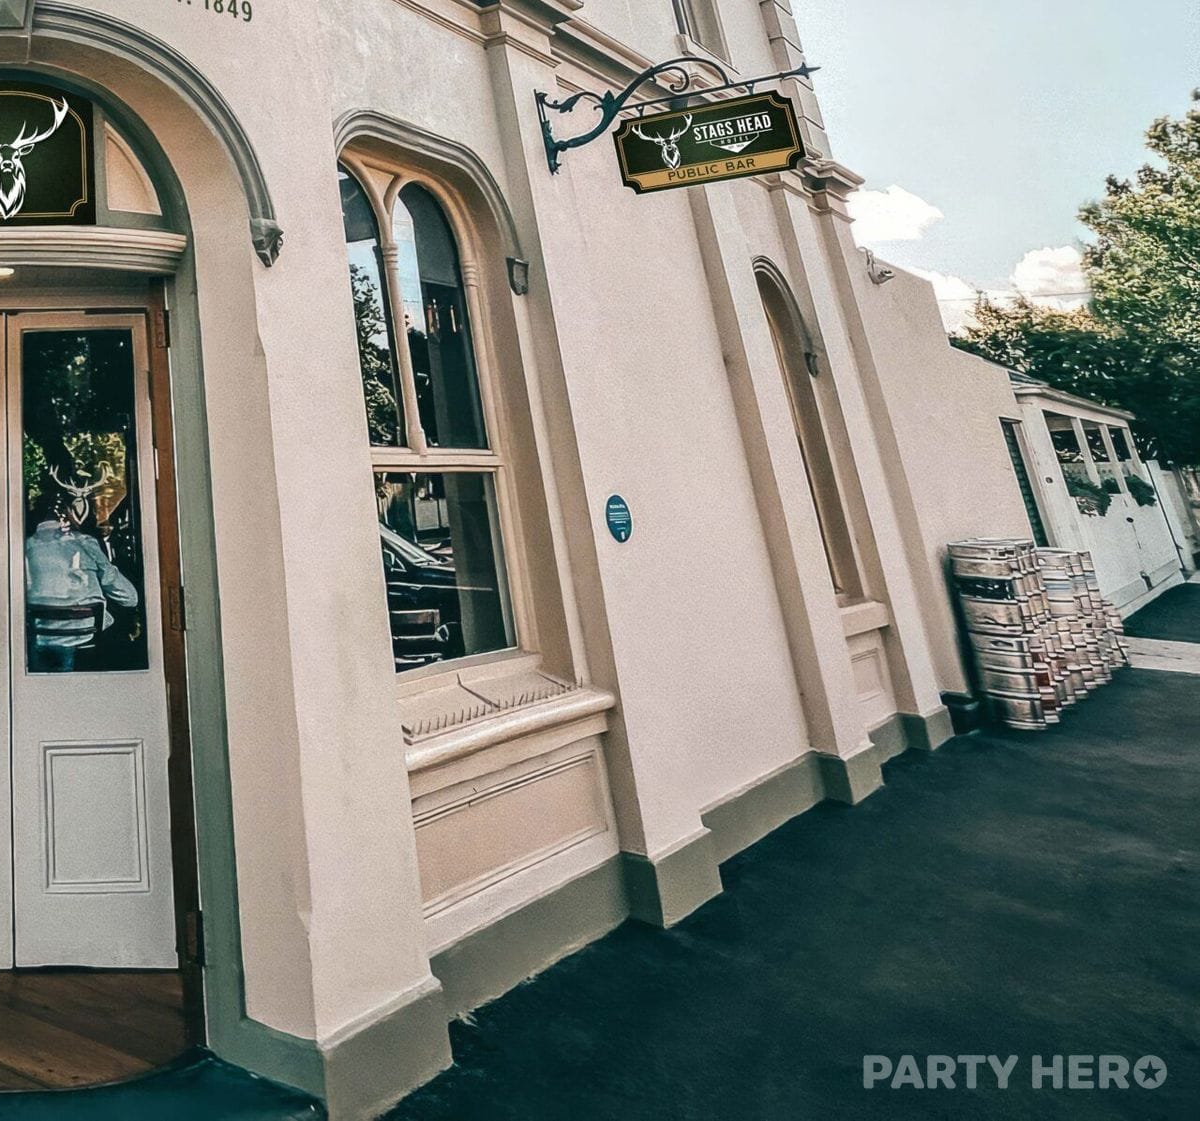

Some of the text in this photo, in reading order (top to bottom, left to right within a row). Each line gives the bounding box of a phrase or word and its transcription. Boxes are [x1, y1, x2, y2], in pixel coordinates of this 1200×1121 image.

[693, 114, 772, 141] STAGS HEAD
[667, 158, 756, 181] PUBLIC BAR
